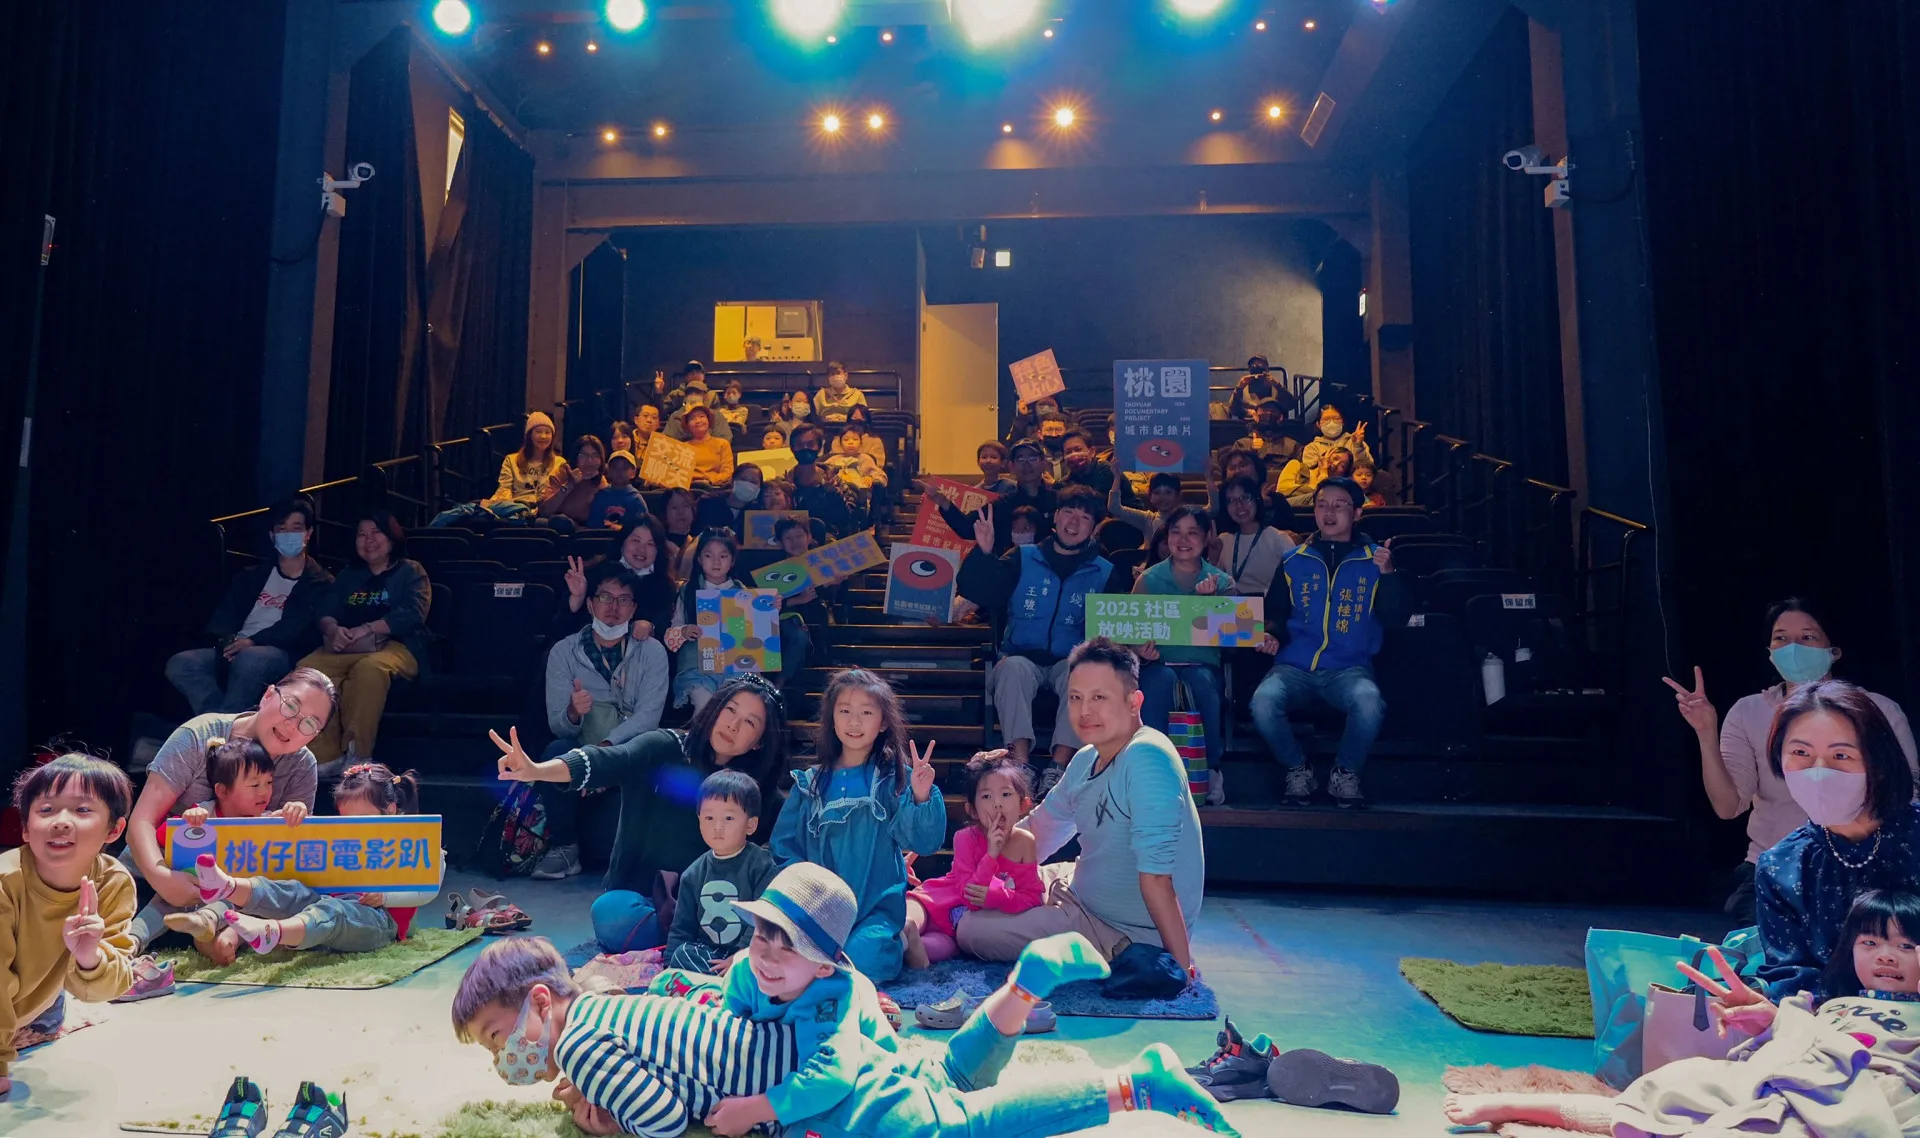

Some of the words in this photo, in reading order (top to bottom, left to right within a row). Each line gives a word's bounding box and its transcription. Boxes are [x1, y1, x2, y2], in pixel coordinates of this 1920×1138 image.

[1124, 366, 1191, 398] 桃園
[1124, 425, 1191, 436] 城市紀錄片
[1096, 600, 1140, 617] 2025
[1144, 600, 1180, 619] 社區
[1097, 620, 1171, 640] 放映活動
[224, 837, 431, 873] 桃仔園電影趴
